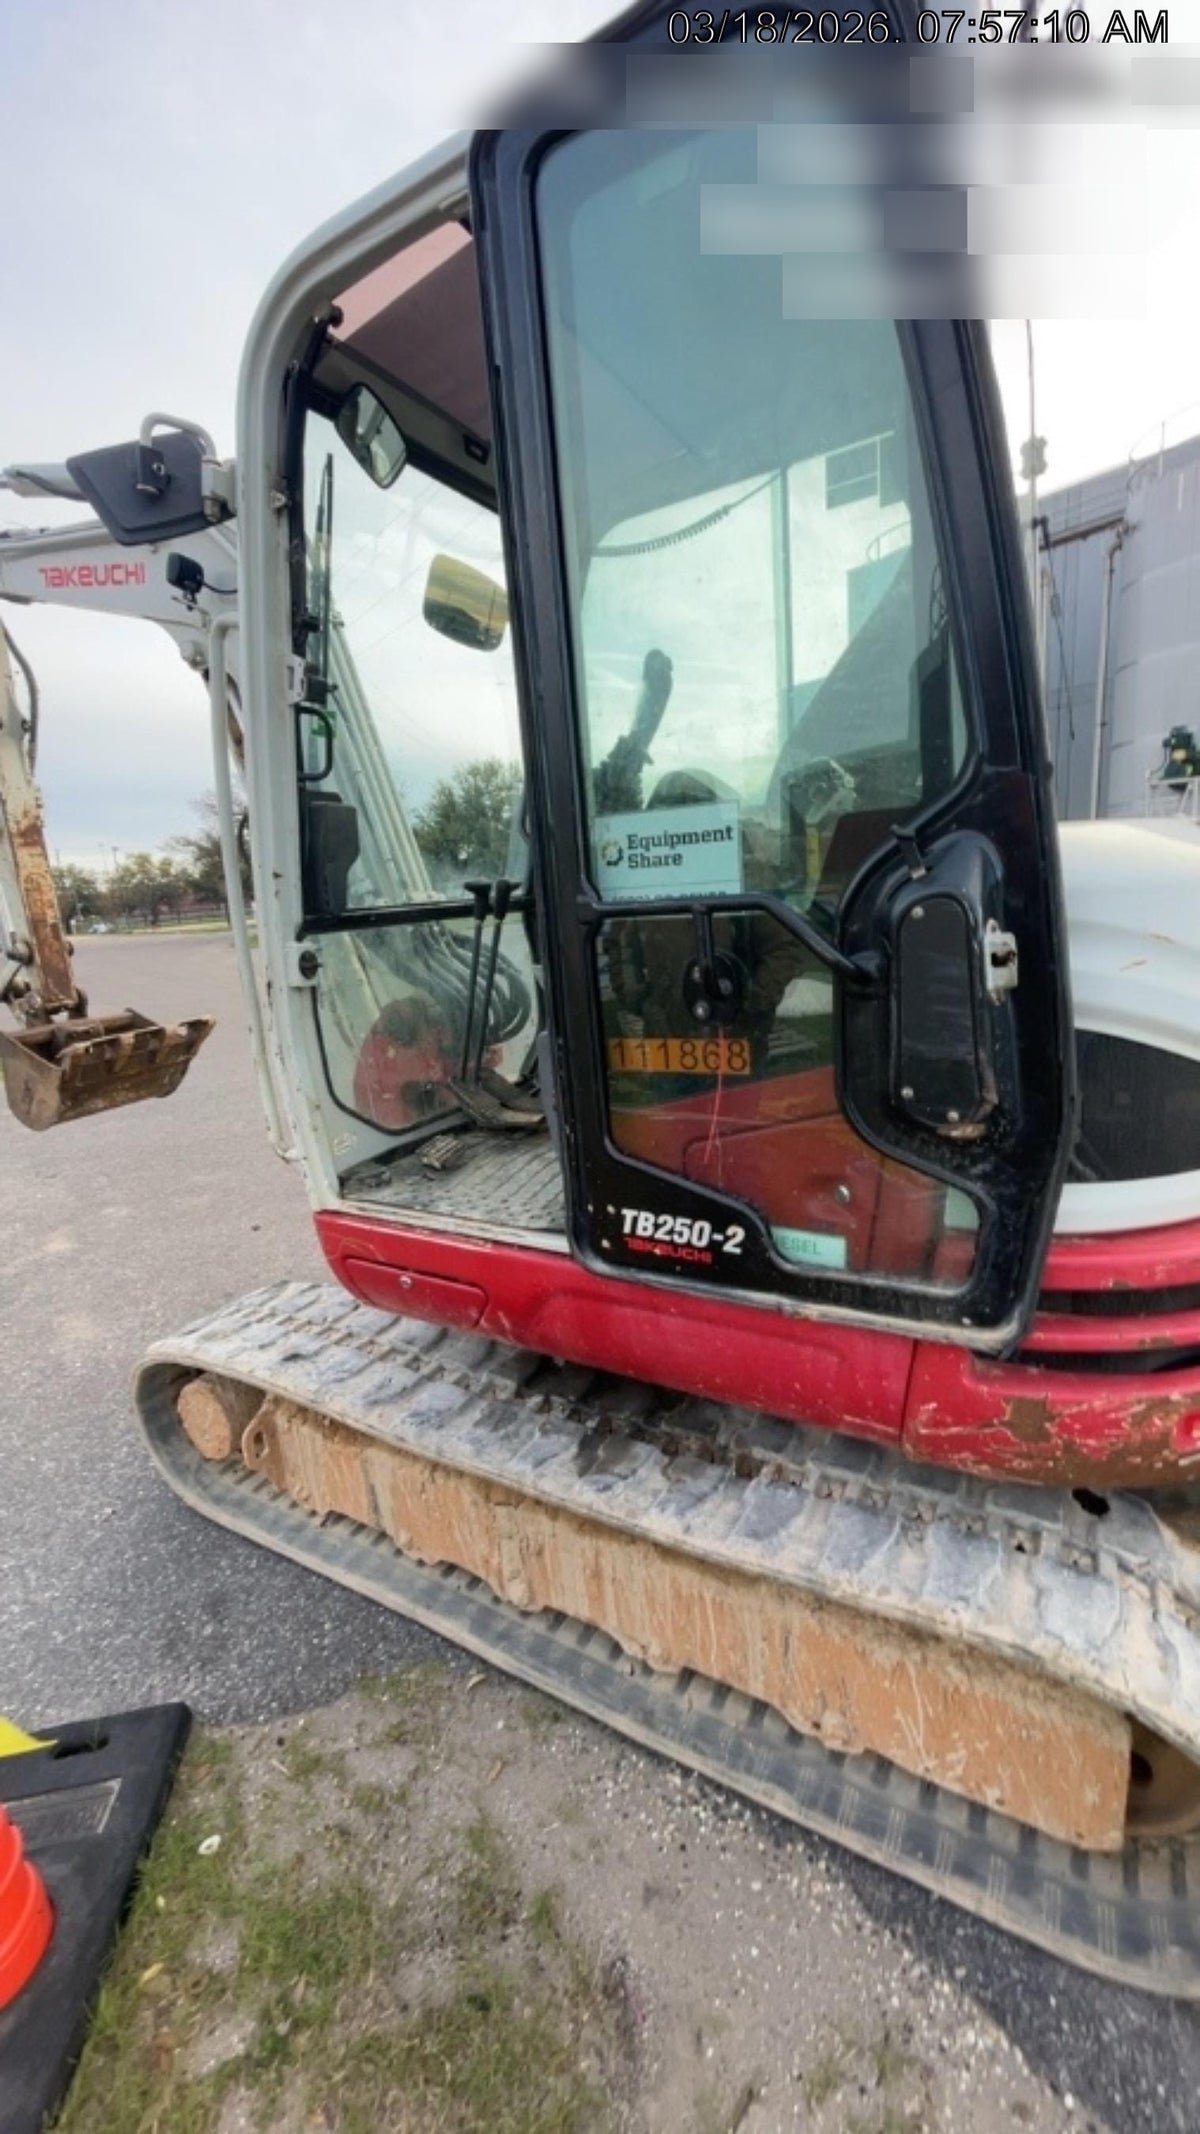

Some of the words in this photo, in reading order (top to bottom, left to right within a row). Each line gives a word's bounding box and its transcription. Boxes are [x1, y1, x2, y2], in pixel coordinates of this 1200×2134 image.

[627, 825, 734, 852] Equipment
[628, 851, 683, 869] Share
[612, 1038, 748, 1071] 111868
[621, 1208, 745, 1255] TB250-2
